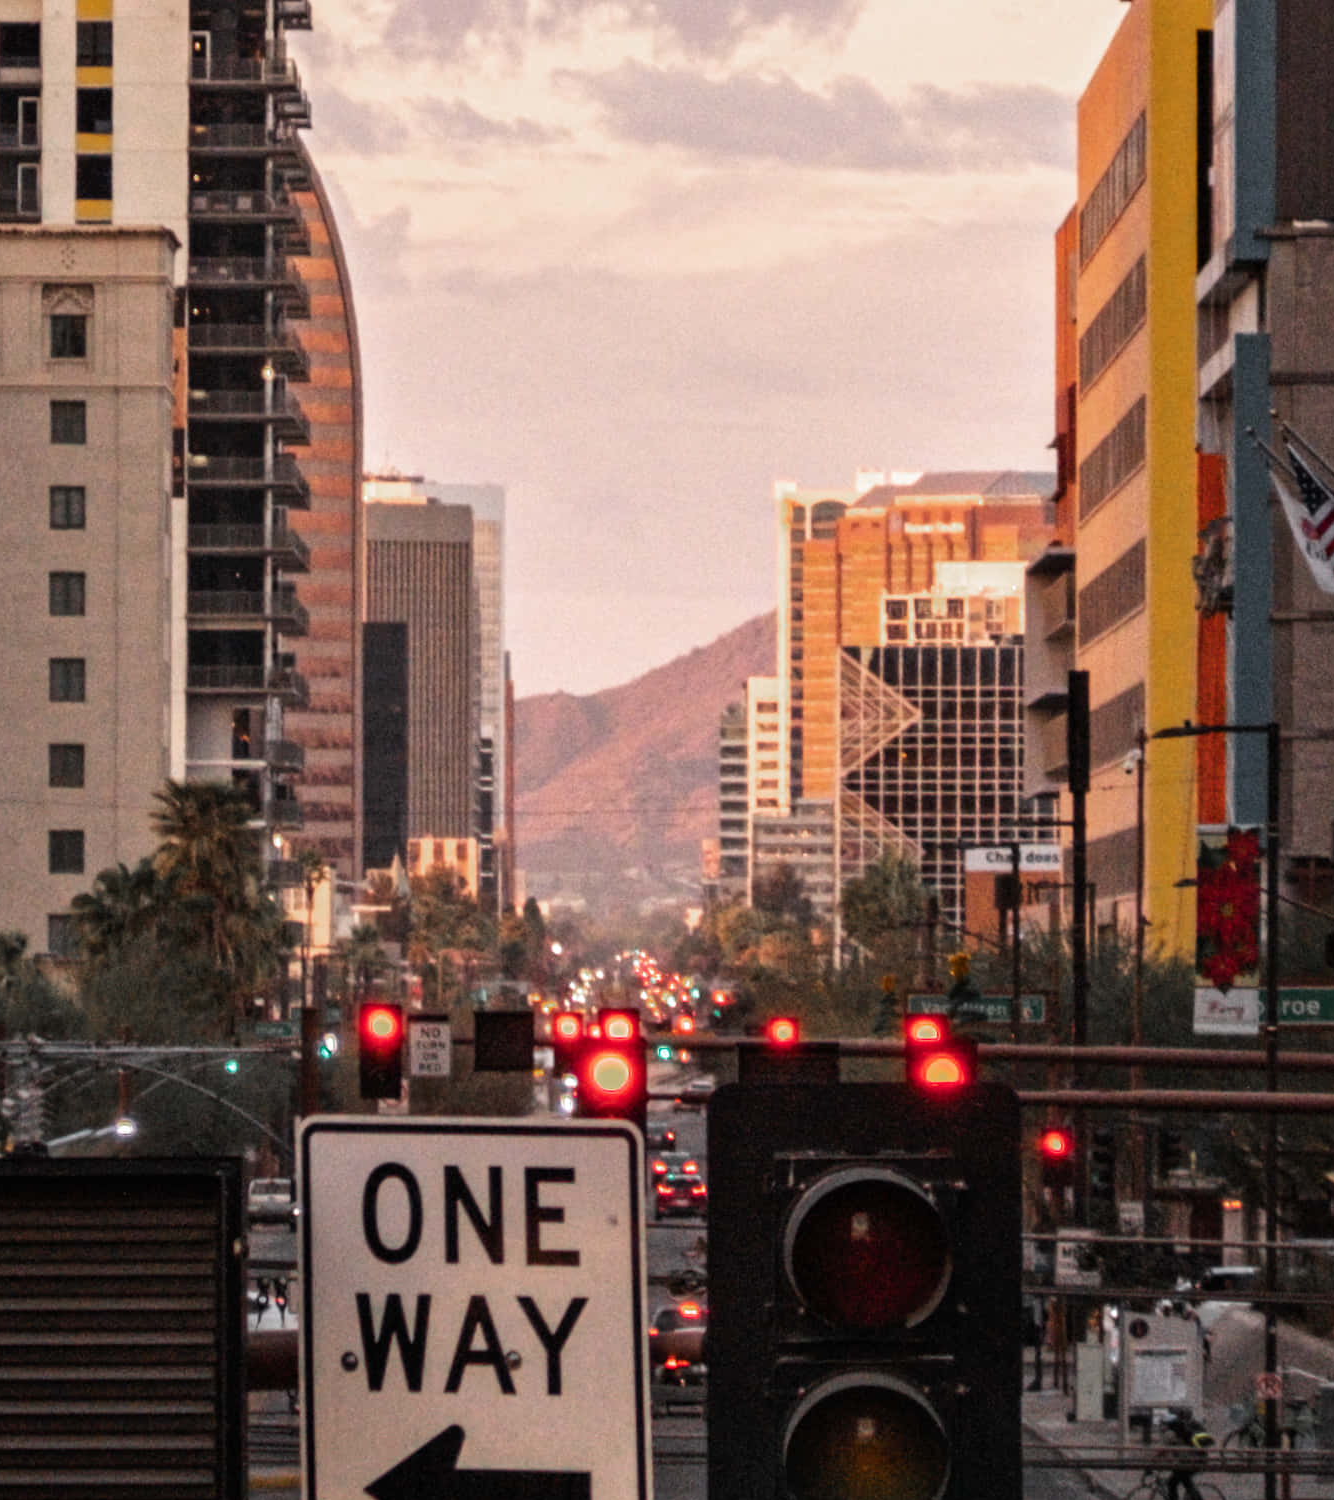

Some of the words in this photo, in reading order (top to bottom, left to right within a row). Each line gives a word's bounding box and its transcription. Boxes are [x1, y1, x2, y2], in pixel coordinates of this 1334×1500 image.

[420, 1027, 441, 1038] NO
[363, 1162, 580, 1266] ONE
[356, 1293, 589, 1395] WAY
